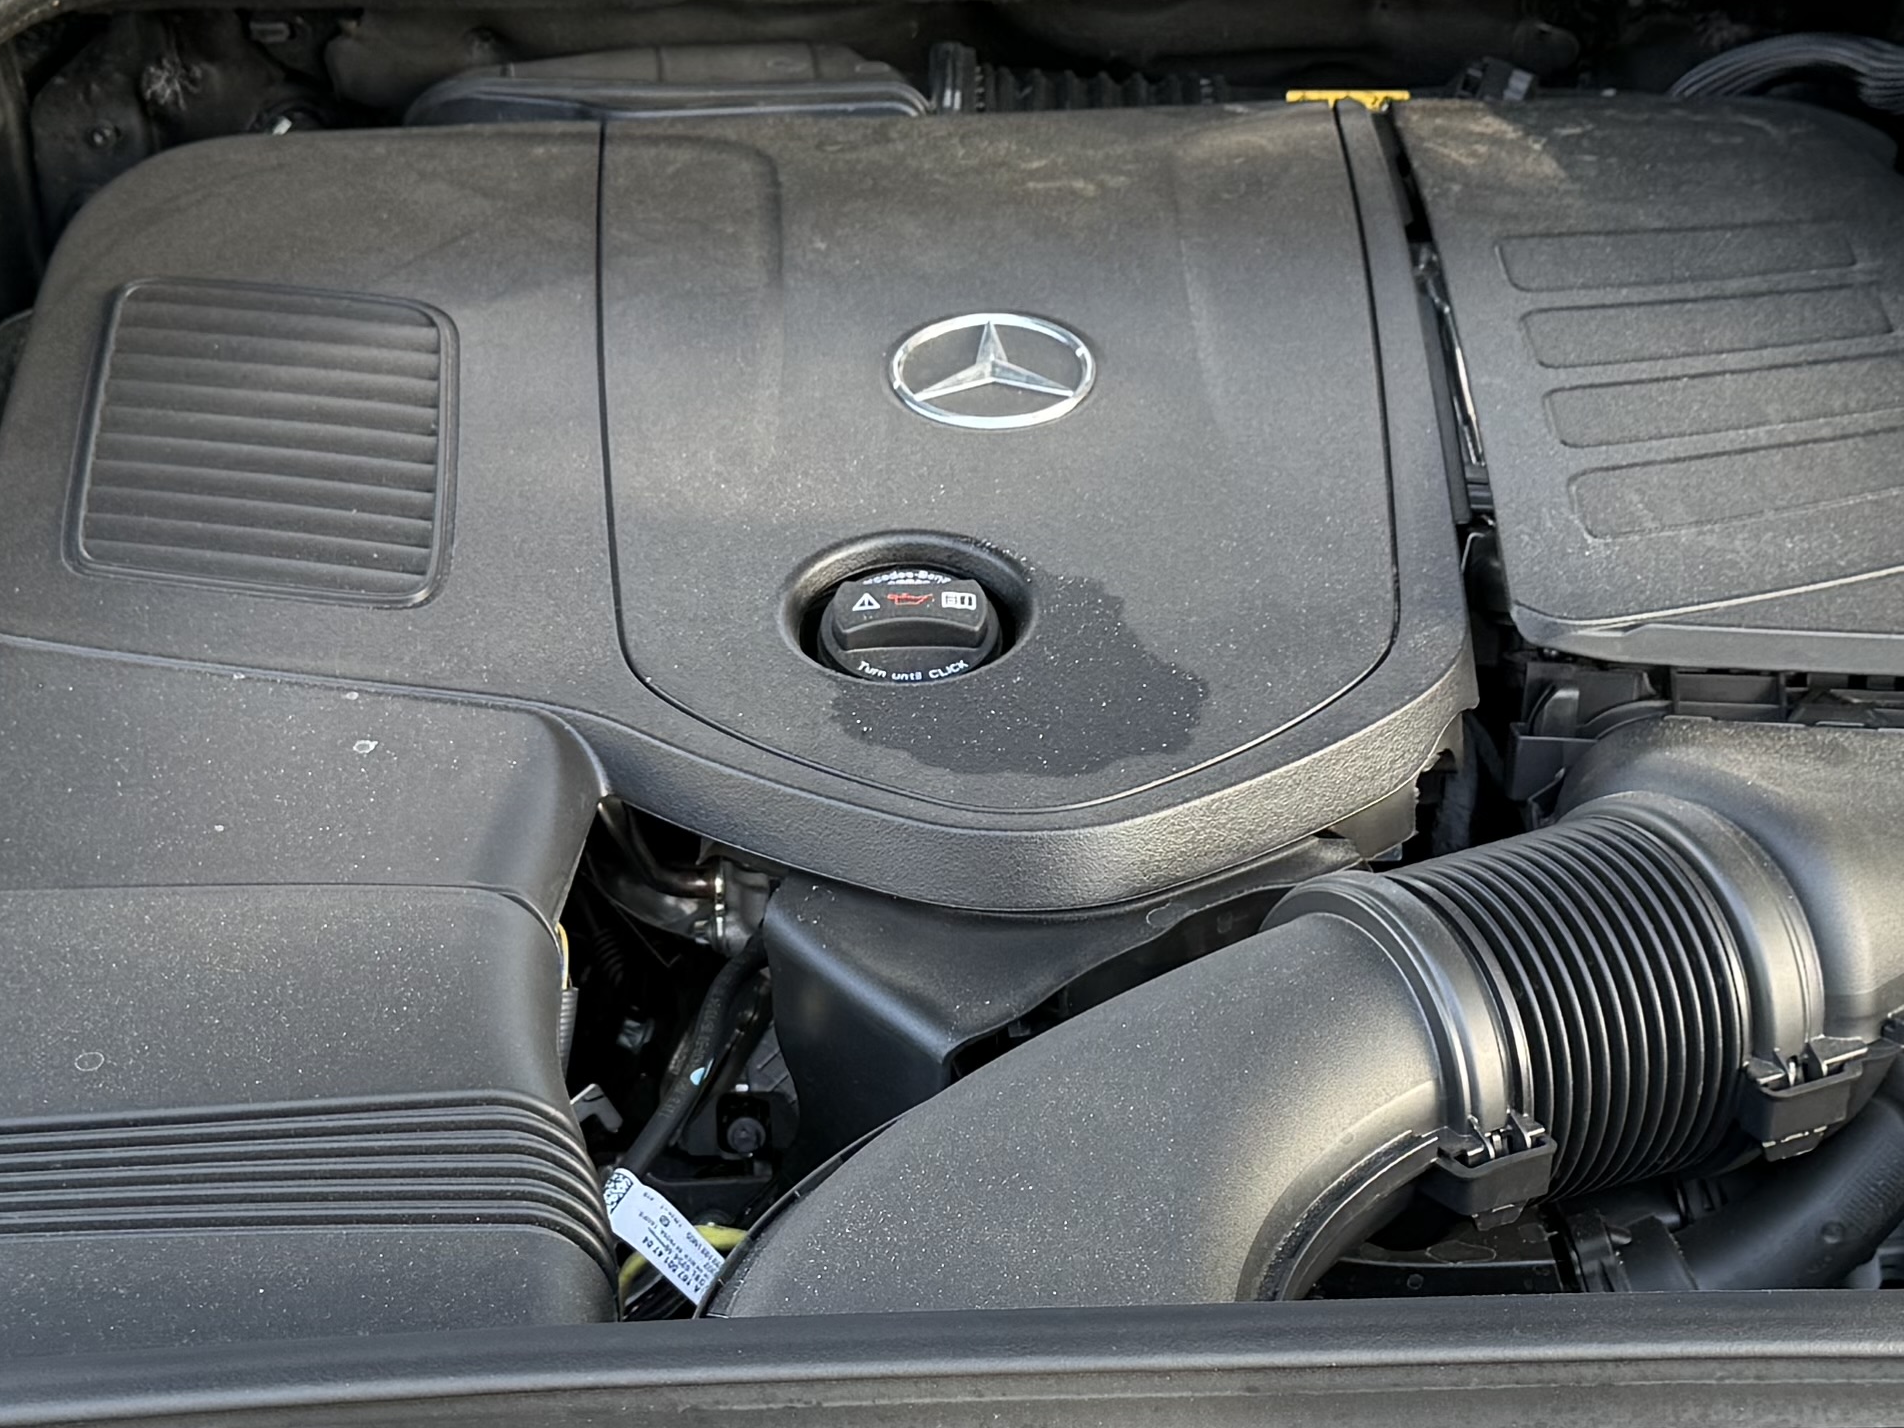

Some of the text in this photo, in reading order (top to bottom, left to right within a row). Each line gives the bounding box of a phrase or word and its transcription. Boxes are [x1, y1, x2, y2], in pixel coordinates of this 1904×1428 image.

[858, 660, 968, 680] Turn until CLICK
